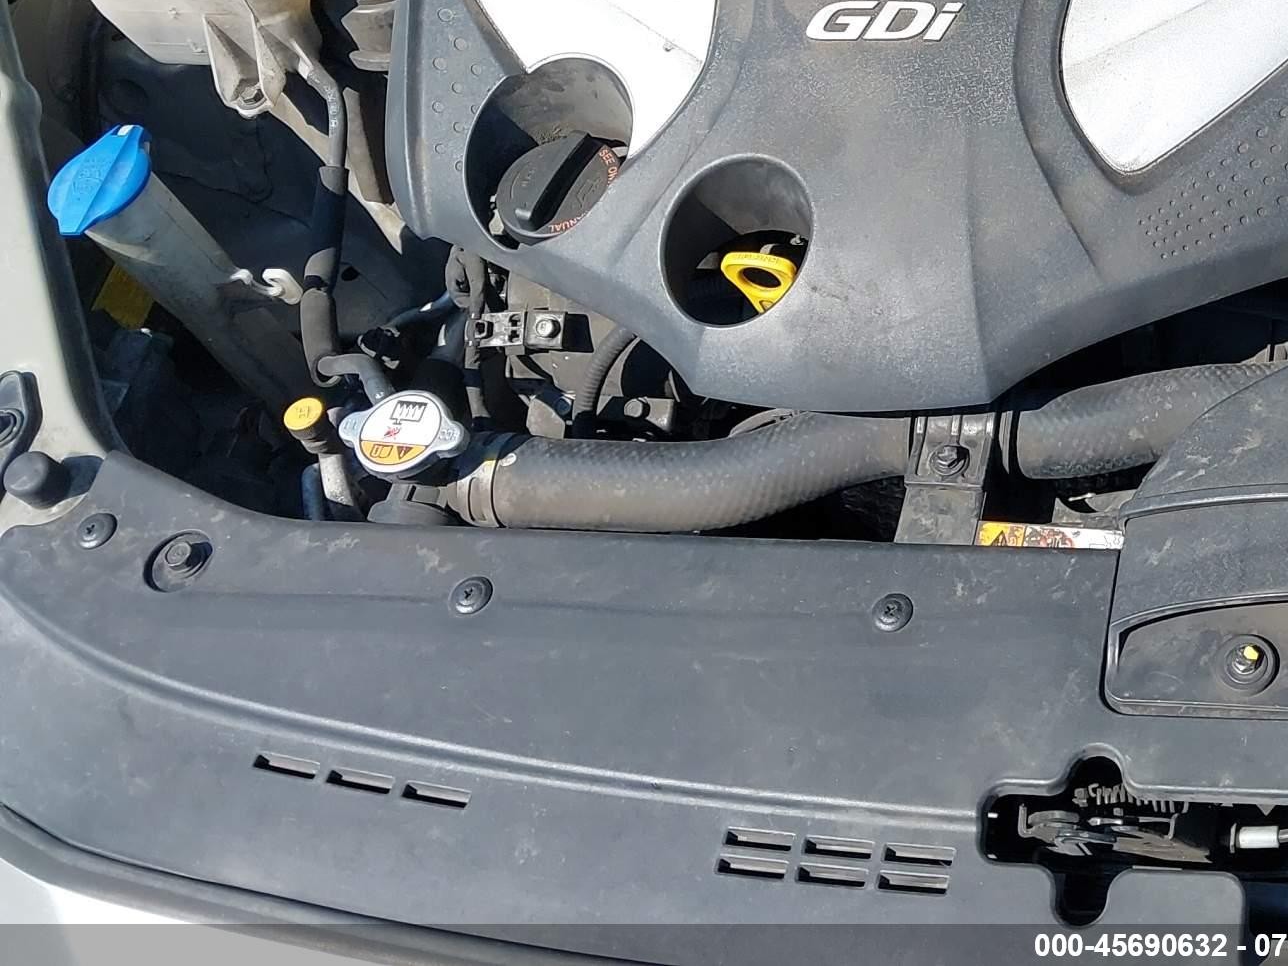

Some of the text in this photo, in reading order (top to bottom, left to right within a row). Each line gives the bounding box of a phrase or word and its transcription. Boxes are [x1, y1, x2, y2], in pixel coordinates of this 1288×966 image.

[804, 0, 964, 41] GDi
[599, 149, 616, 166] SEE
[548, 211, 588, 233] NUAL
